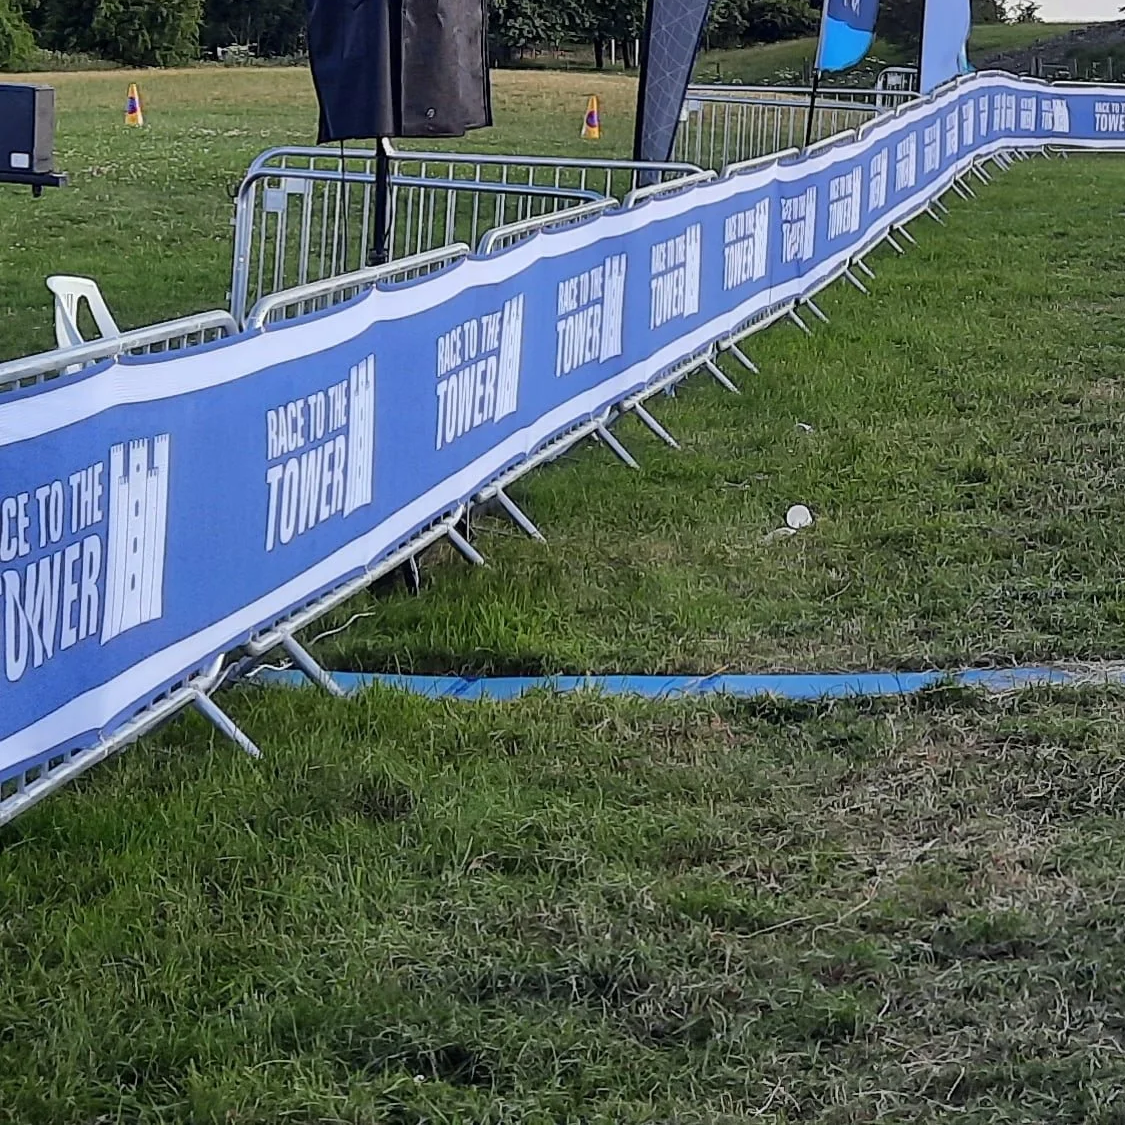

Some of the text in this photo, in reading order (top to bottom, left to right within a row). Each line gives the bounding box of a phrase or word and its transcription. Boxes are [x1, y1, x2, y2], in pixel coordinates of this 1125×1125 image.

[1111, 103, 1119, 113] TO
[667, 238, 675, 269] TO
[723, 237, 754, 291] TOWER
[557, 265, 604, 316] RACE TO THE
[650, 266, 685, 331] TOWER
[437, 311, 502, 377] RACE TO THE
[556, 304, 602, 378] TOWER
[266, 379, 348, 460] RACE TO THE
[435, 355, 497, 451] TOWER
[36, 480, 64, 548] TO
[69, 461, 103, 534] THE
[266, 434, 346, 552] TOWER
[0, 534, 102, 682] OWER
